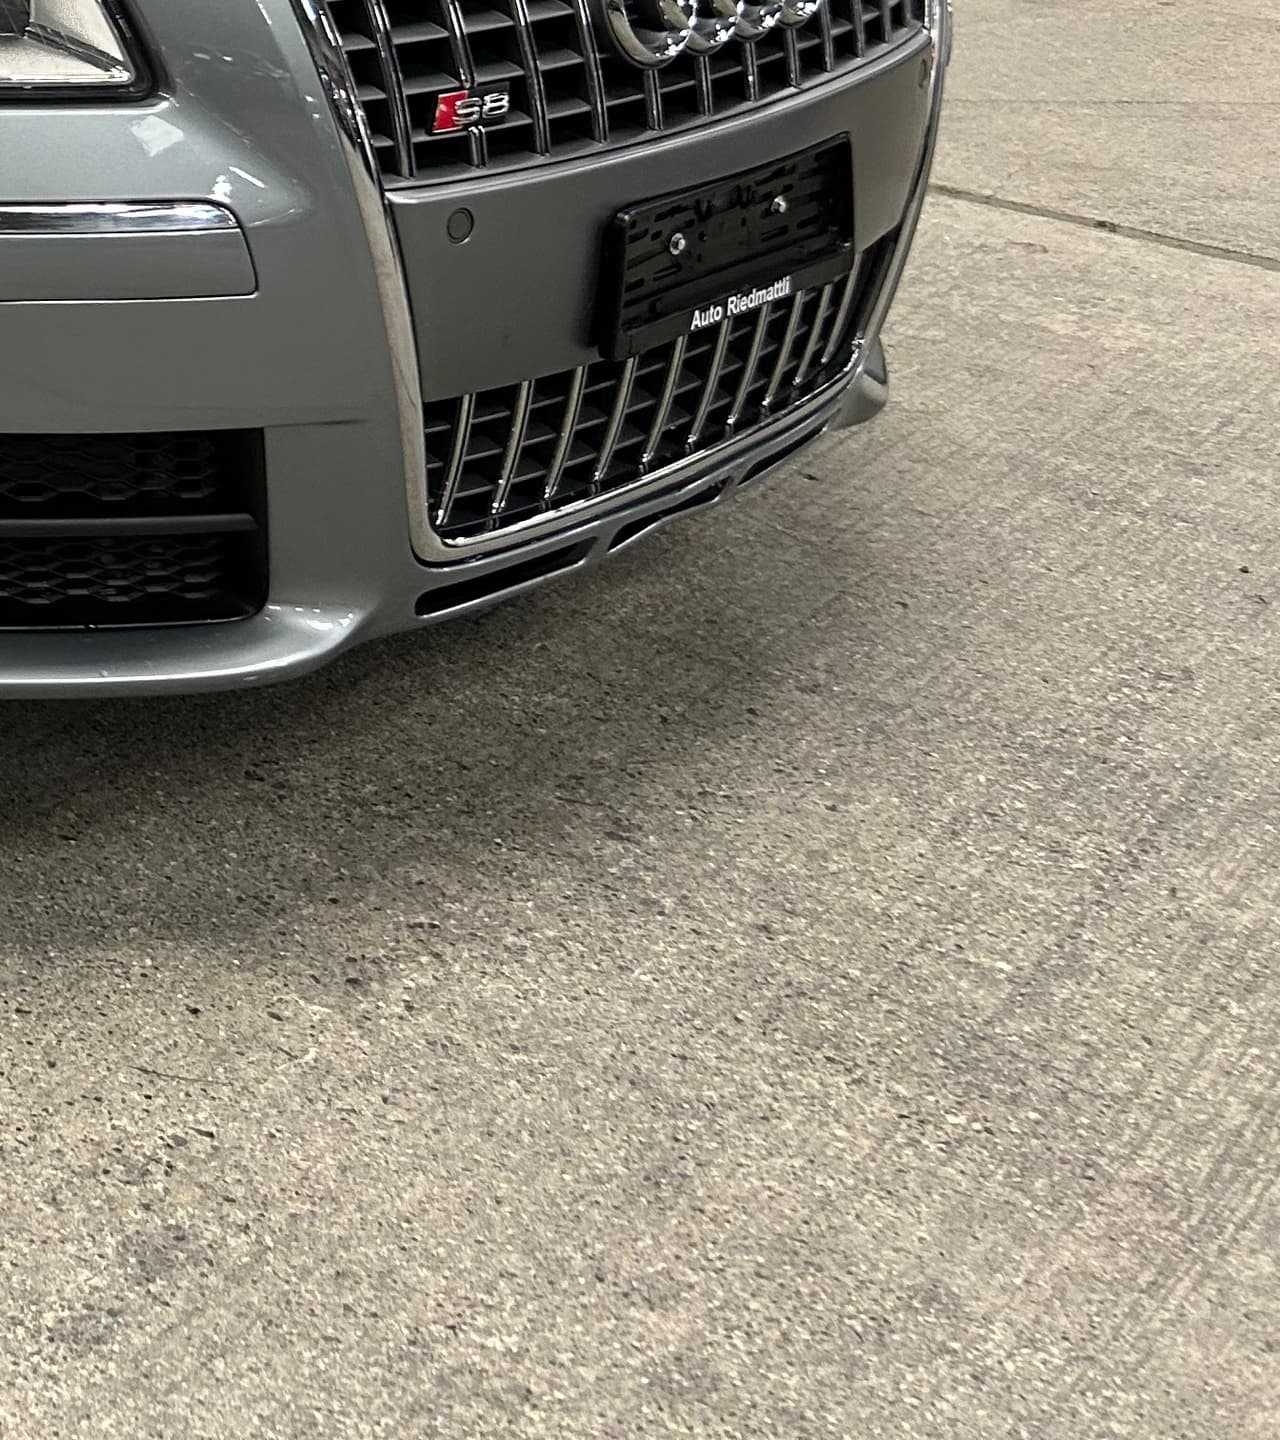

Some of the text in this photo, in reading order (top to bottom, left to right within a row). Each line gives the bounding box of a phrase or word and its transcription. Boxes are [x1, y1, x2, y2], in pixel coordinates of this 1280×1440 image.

[452, 92, 510, 125] S8
[690, 275, 791, 331] Auto Riedmattli
